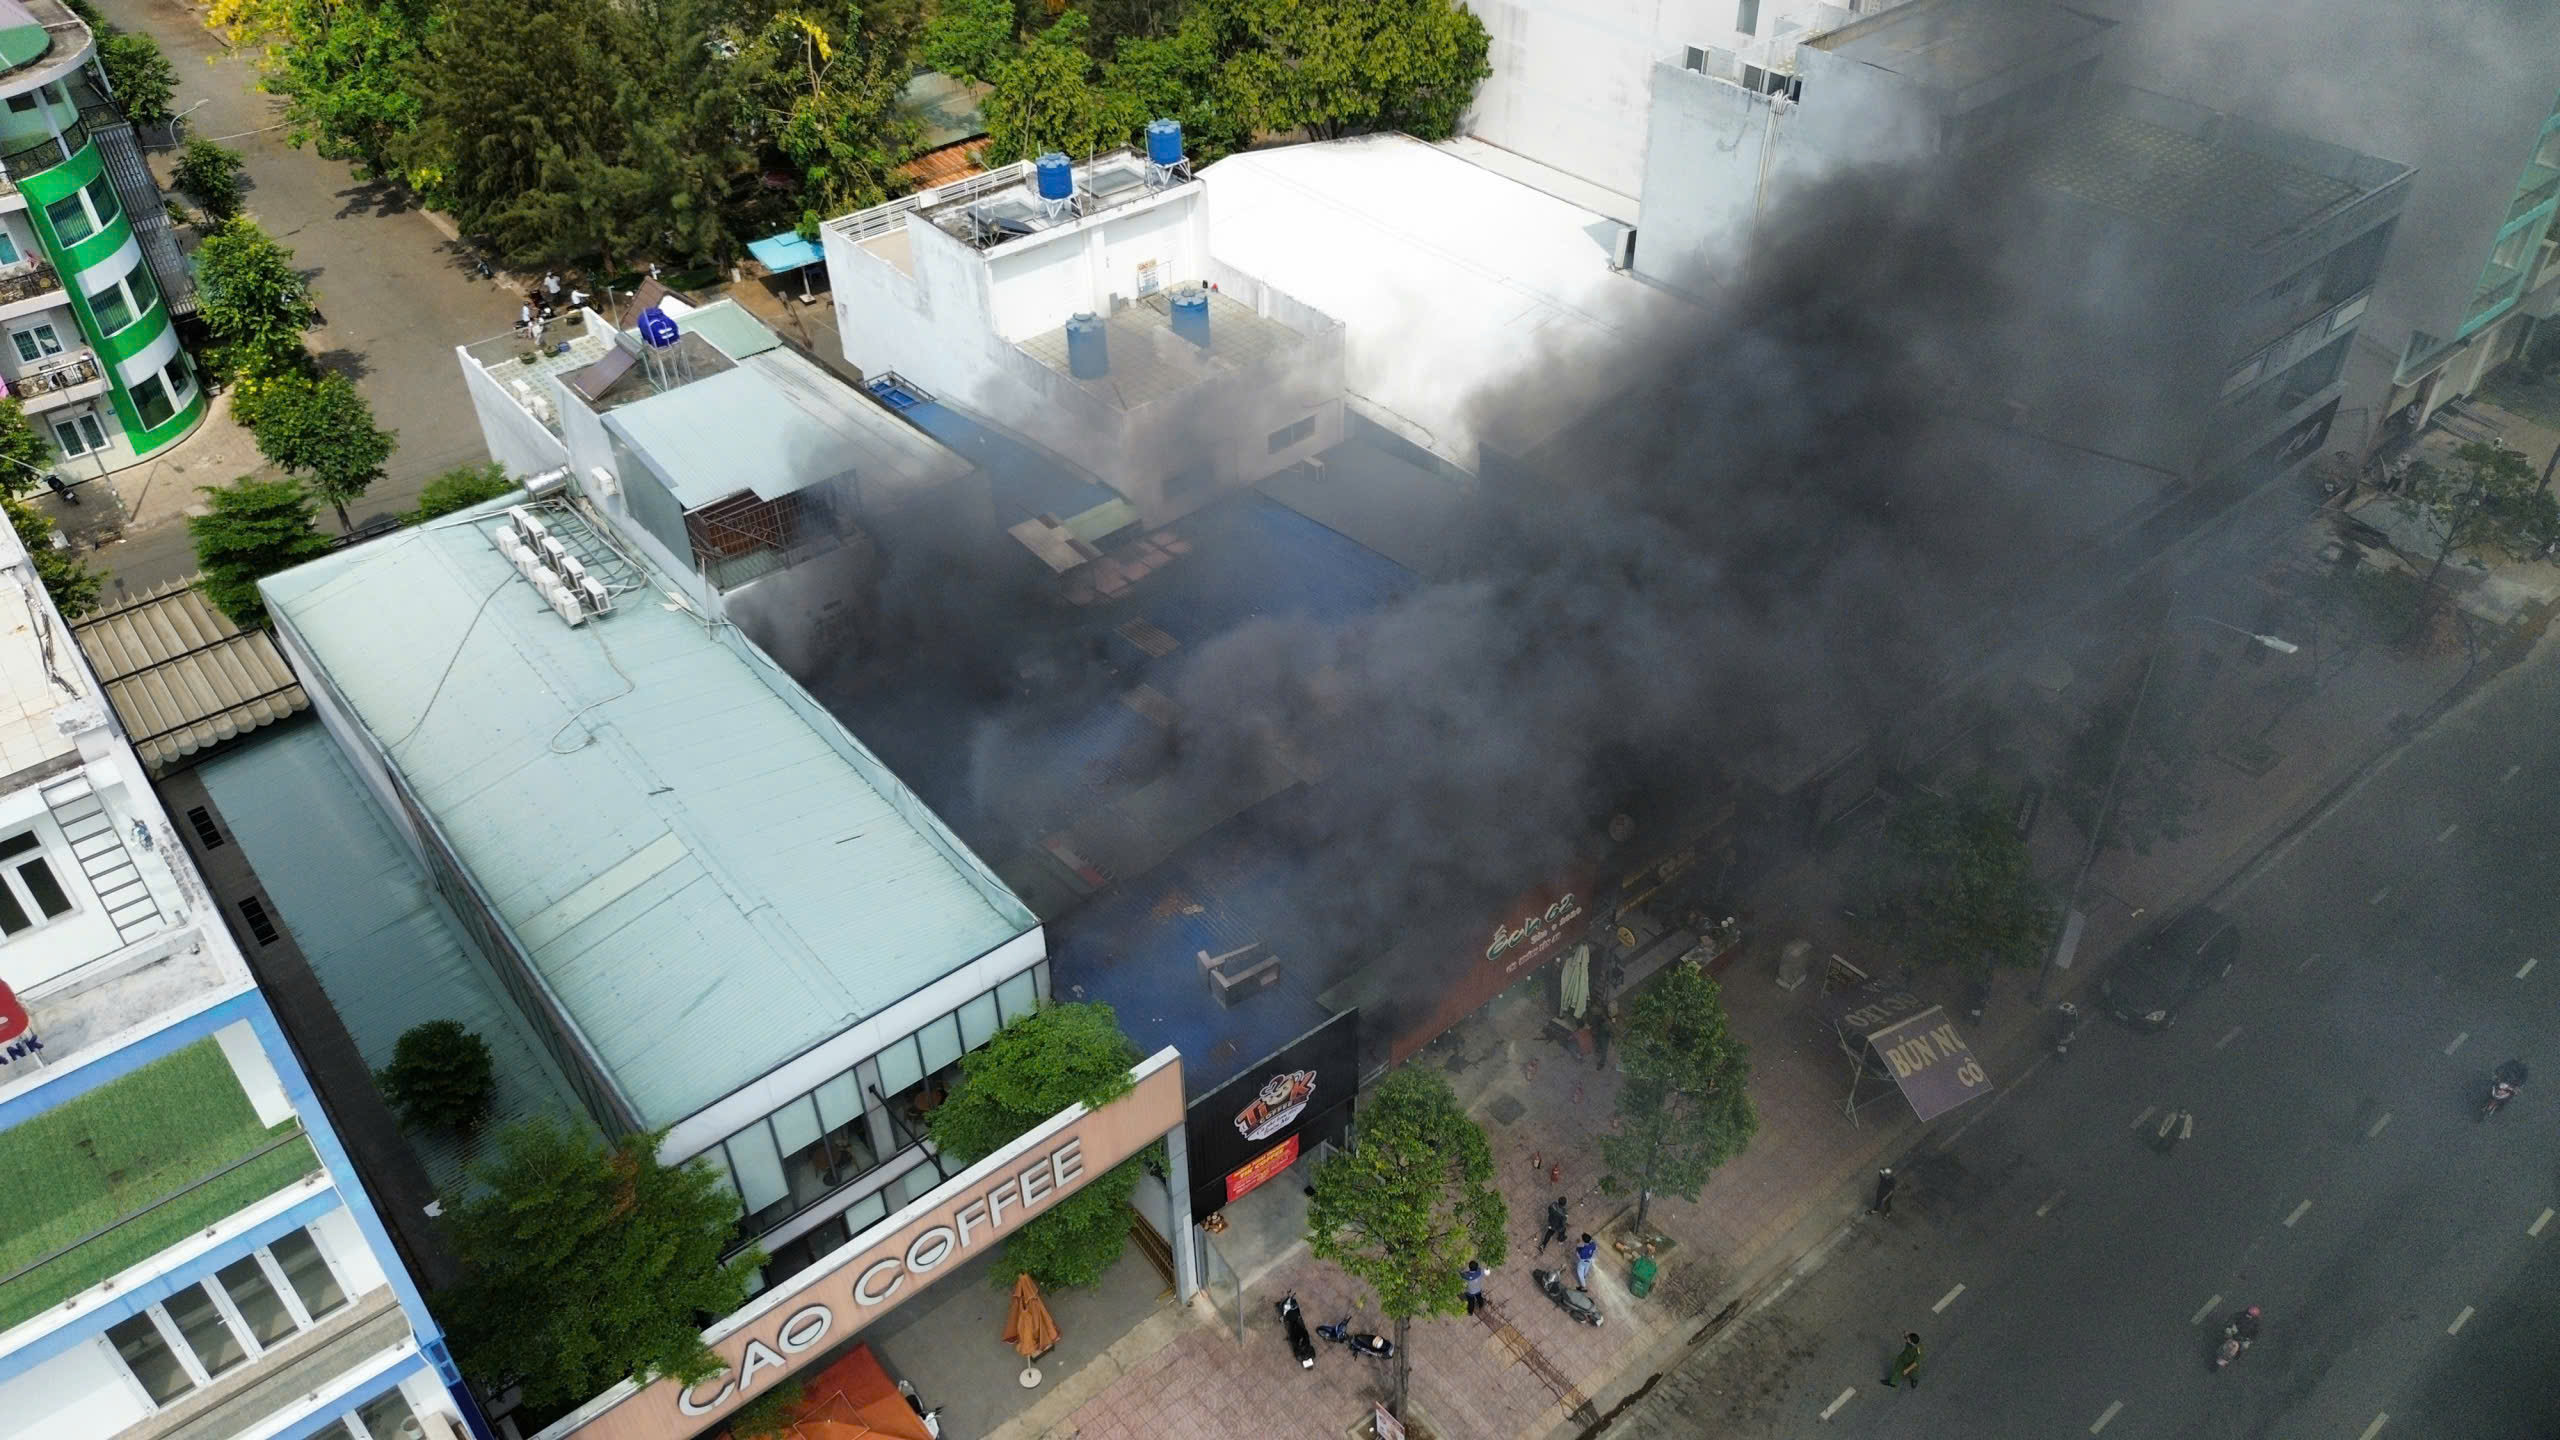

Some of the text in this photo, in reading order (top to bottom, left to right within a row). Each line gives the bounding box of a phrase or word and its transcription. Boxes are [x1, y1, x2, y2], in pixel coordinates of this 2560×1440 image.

[1886, 1034, 1938, 1078] BÚN
[678, 1136, 1085, 1417] CAO COFFEE
